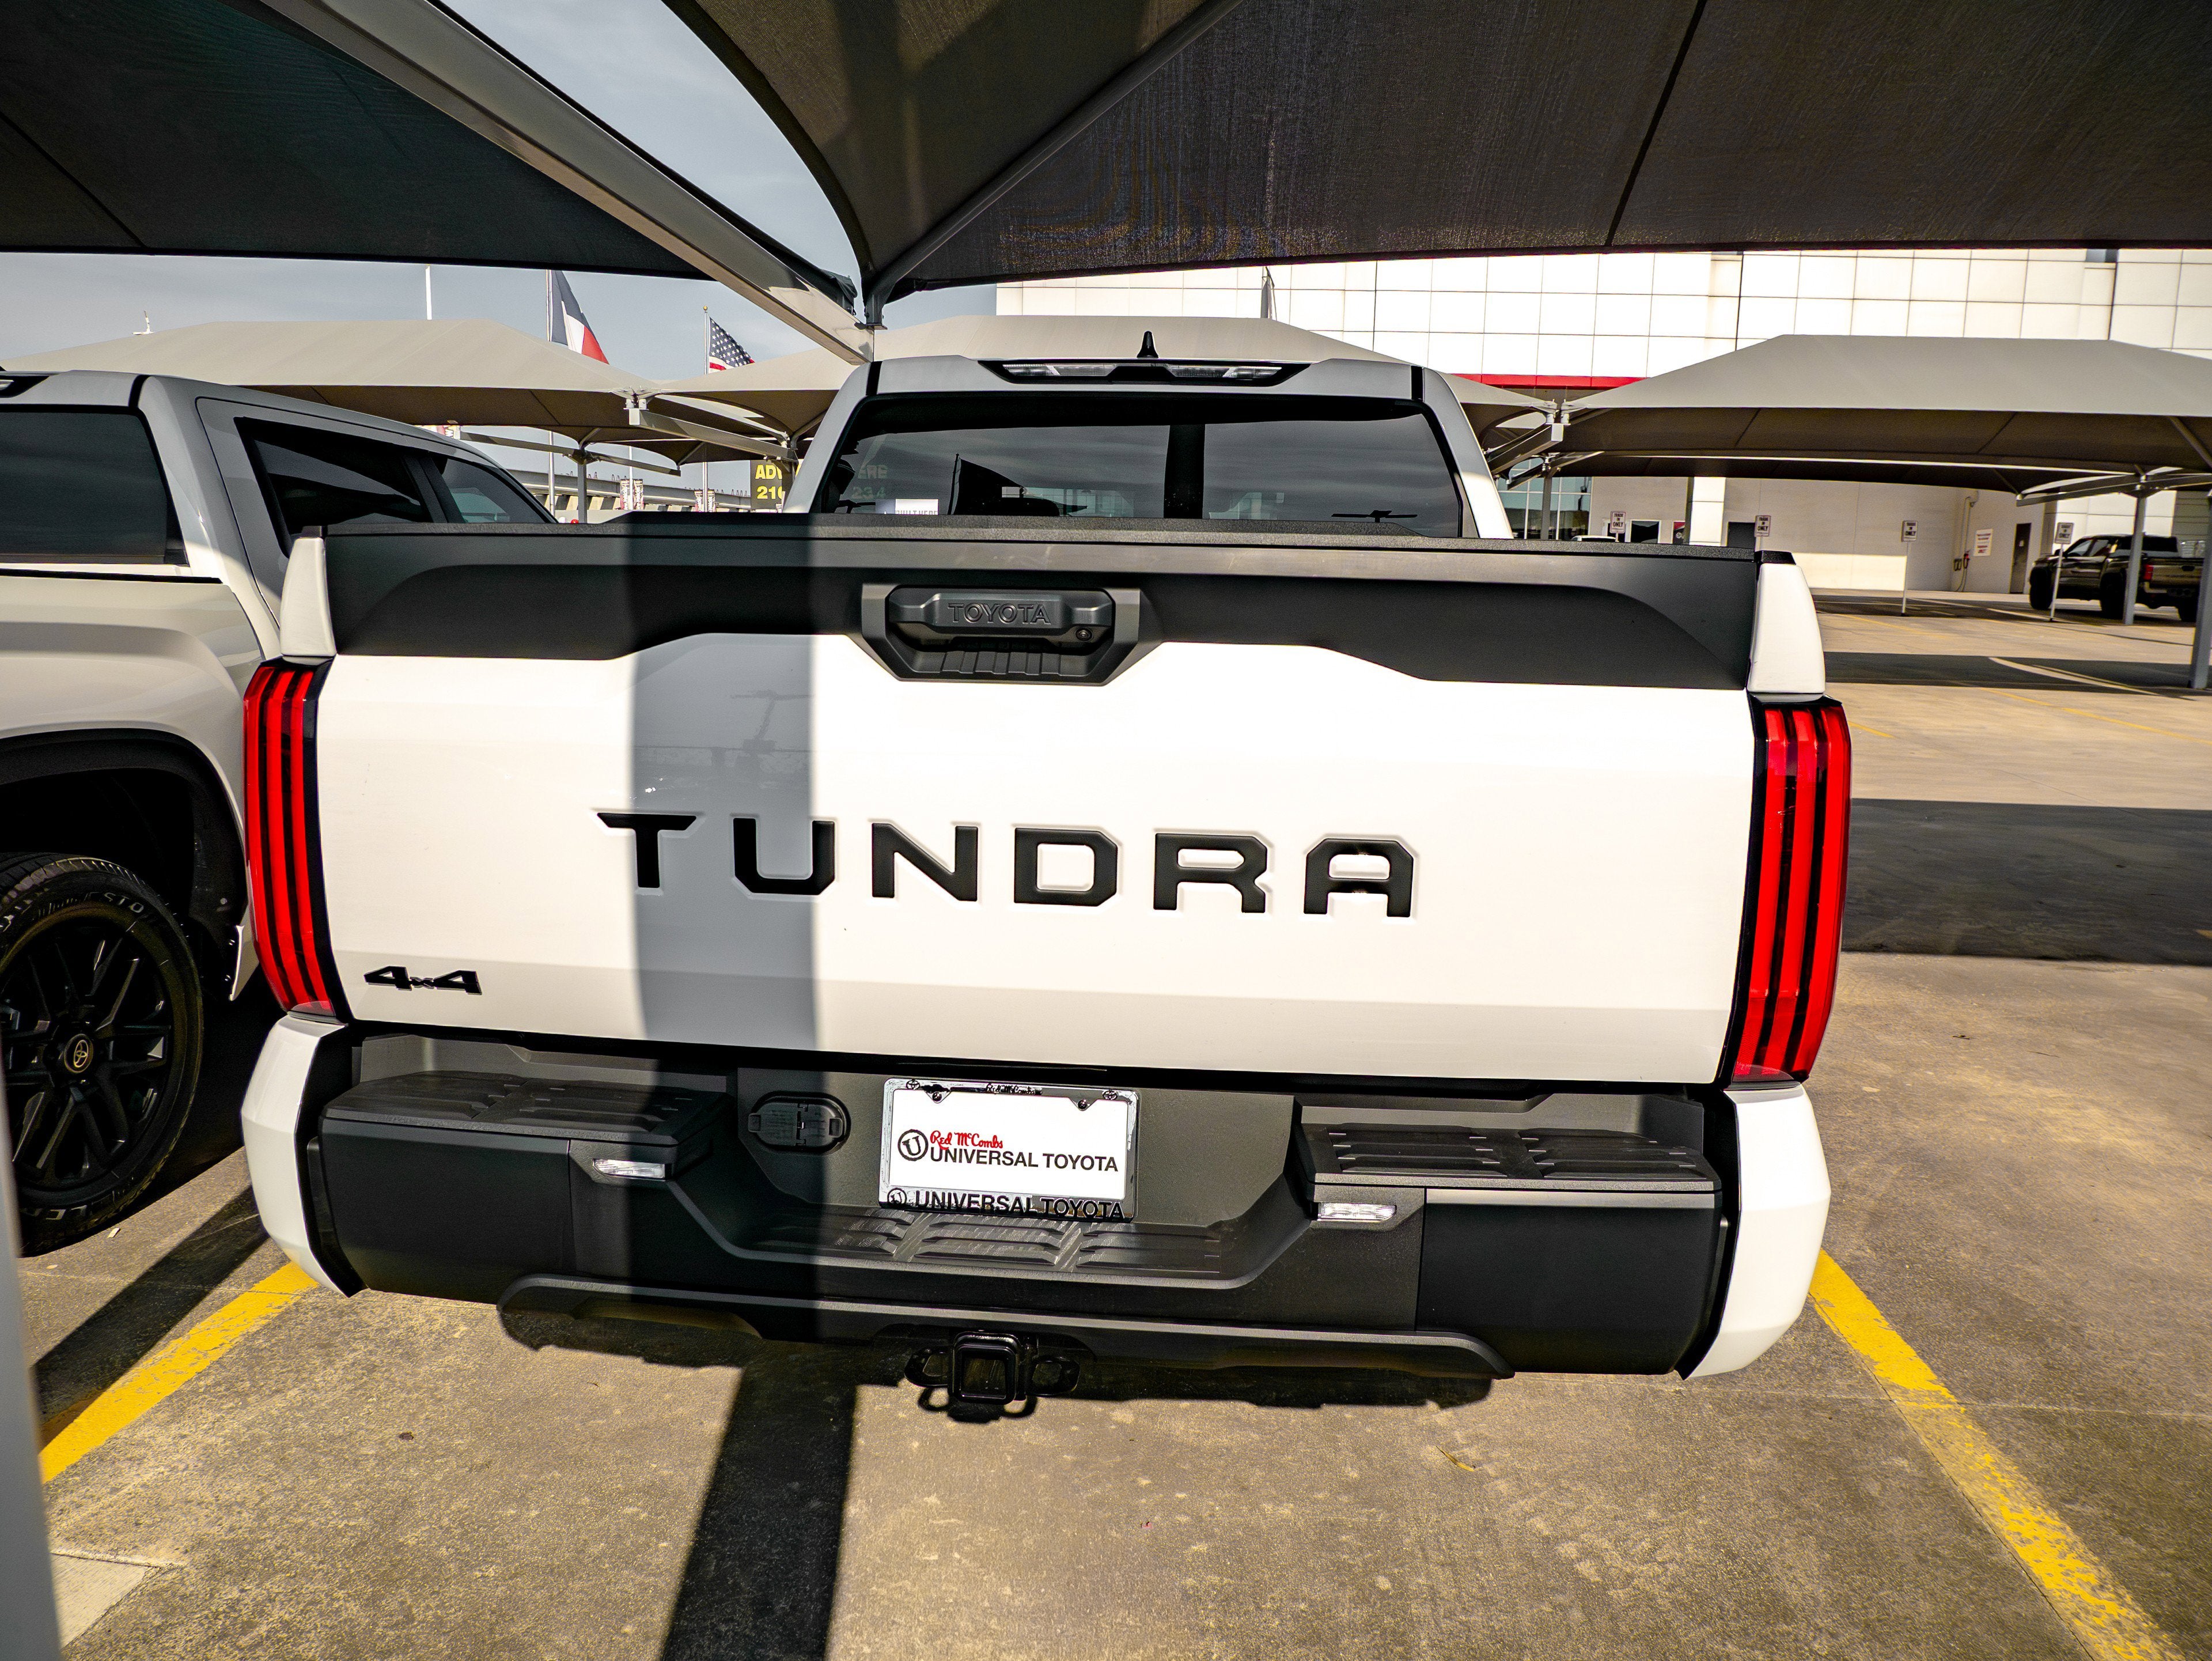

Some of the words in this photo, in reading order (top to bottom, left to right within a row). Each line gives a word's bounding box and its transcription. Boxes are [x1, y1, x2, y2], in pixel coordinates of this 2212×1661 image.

[948, 603, 1051, 625] TOYOTA
[596, 812, 1415, 918] TUNDRA
[930, 1130, 952, 1150] Red
[954, 1132, 1003, 1148] McCombs
[930, 1147, 1038, 1168] UNIVERSAL
[1043, 1153, 1118, 1172] TOYOTA
[915, 1190, 1037, 1214] UNIVERSAL
[1040, 1197, 1125, 1220] TOYOTA
